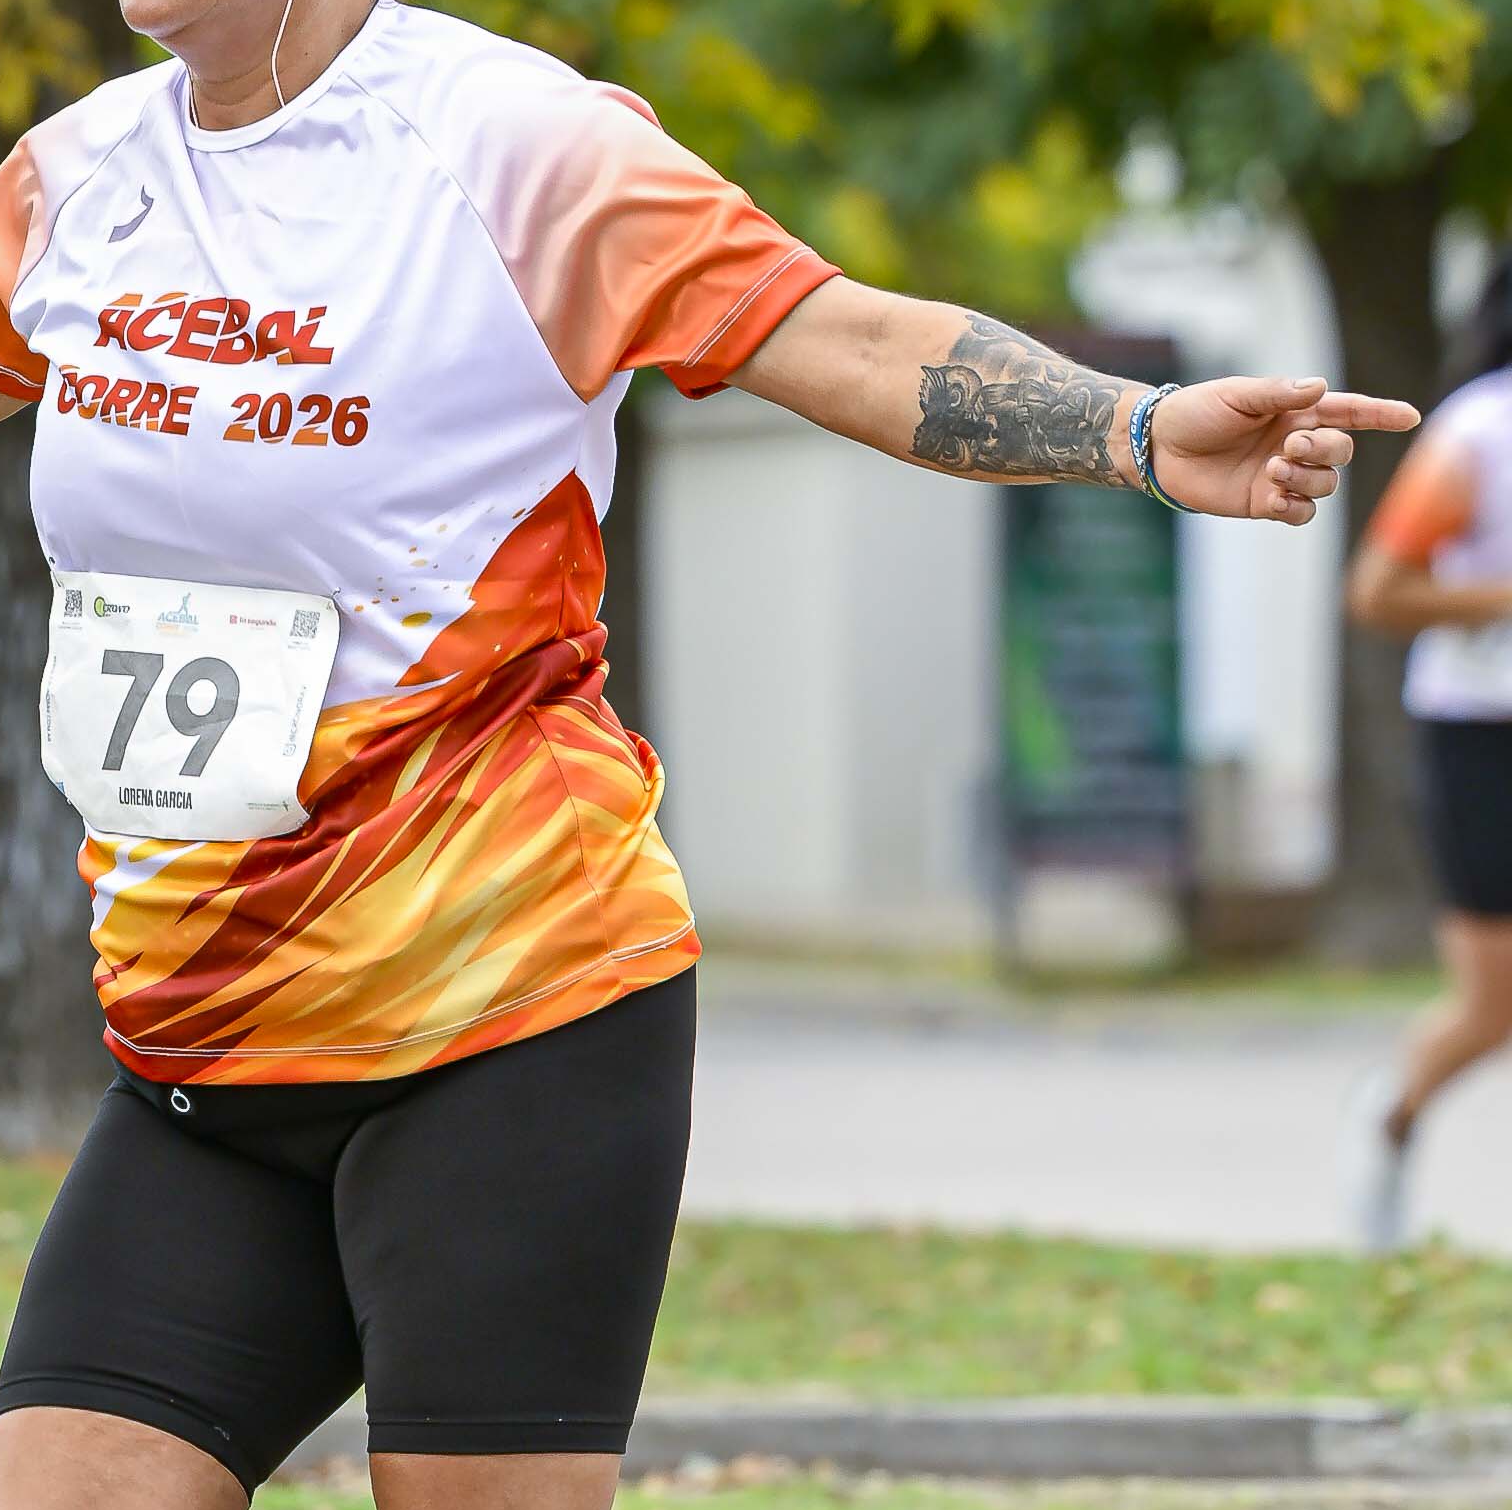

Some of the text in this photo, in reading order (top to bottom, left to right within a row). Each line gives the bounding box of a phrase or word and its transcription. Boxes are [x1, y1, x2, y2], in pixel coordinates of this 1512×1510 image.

[94, 292, 335, 366] ACEBAL
[57, 364, 371, 447] CORRE 2026
[101, 649, 240, 778] 79
[118, 786, 193, 810] LORENA GARCIA
